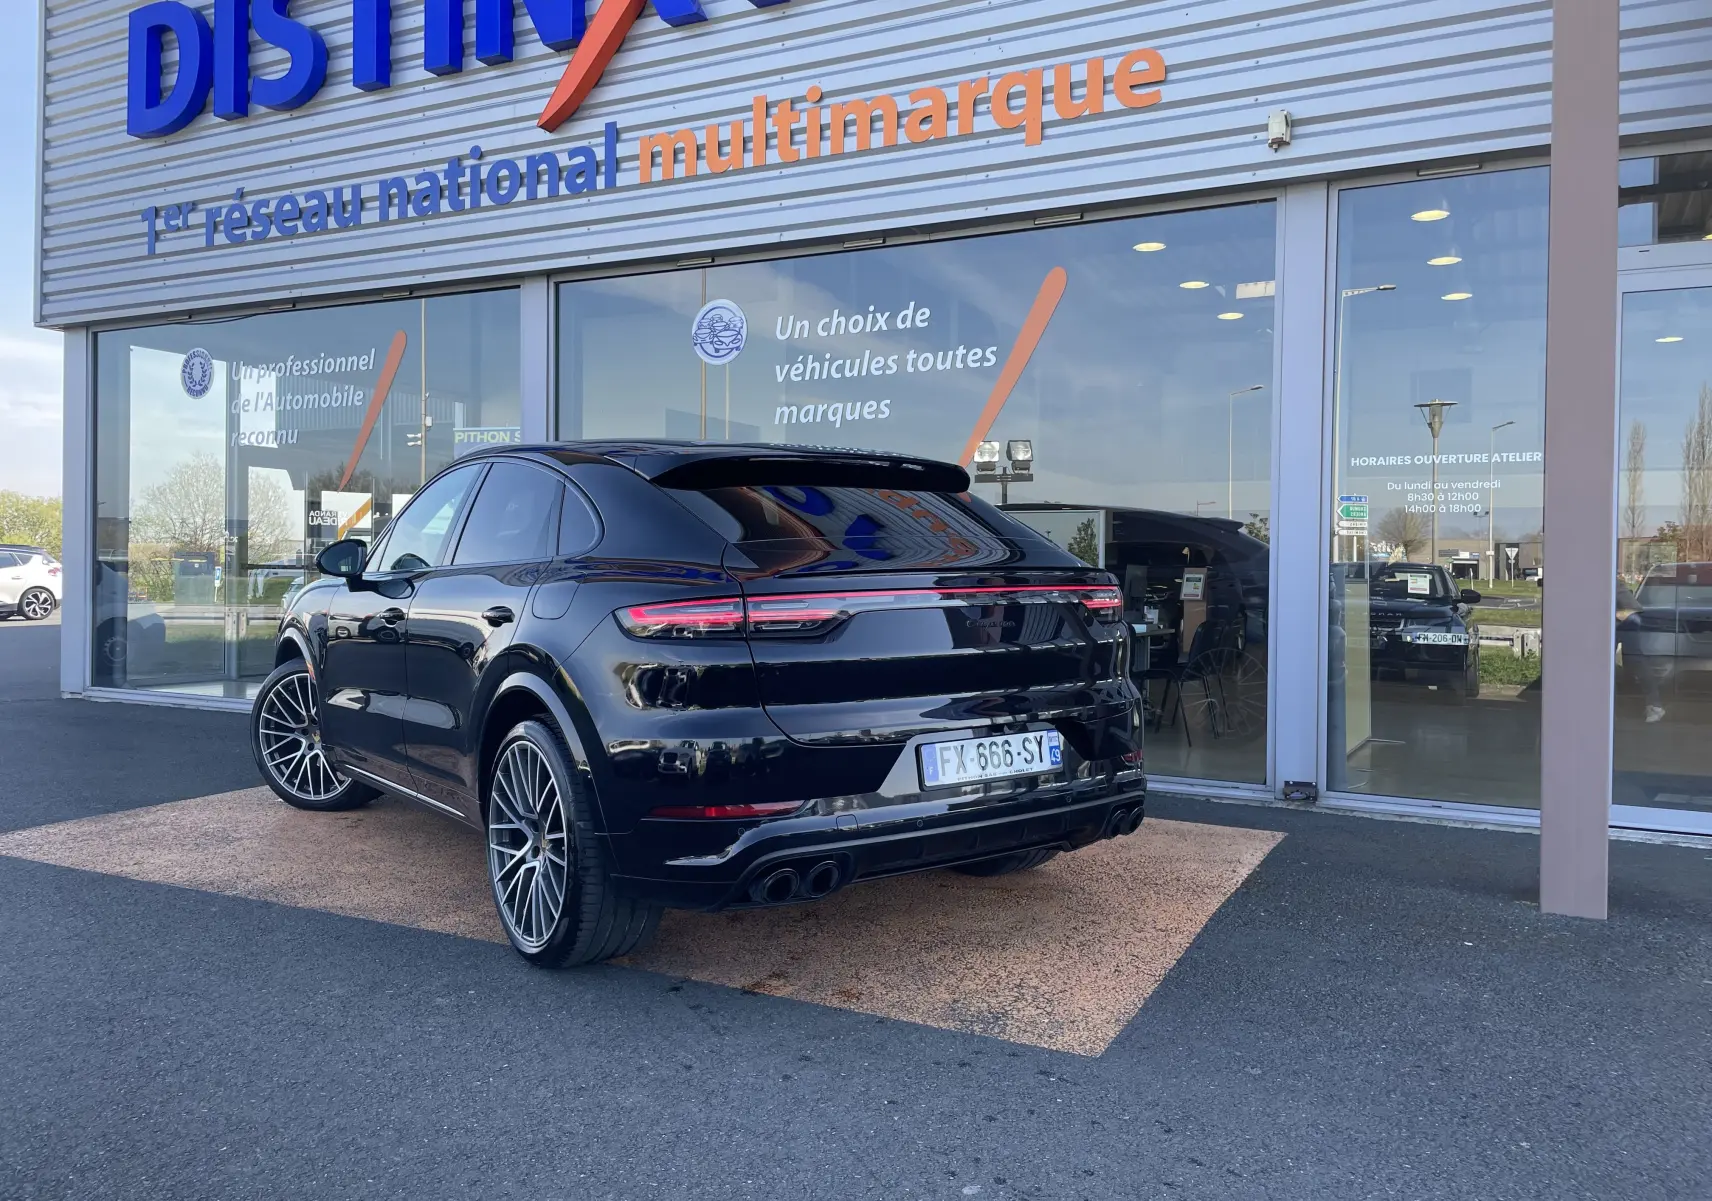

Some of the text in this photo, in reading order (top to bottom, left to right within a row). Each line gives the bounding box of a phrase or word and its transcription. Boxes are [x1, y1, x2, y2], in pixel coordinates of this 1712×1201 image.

[141, 48, 1167, 255] 1er réseau national multimarque
[776, 301, 931, 341] Un choix de
[231, 347, 376, 384] Un professionnel
[776, 345, 997, 382] véhicules toutes
[231, 385, 364, 413] de l'Automobile
[774, 399, 892, 428] marques
[231, 428, 299, 447] reconnu
[454, 431, 510, 443] PITHON
[1351, 452, 1543, 467] HORAIRES OUVERTURE ATELIER
[1387, 482, 1402, 490] Du
[1404, 481, 1432, 490] lundi
[1451, 480, 1501, 489] vendredi
[1407, 492, 1479, 502] 8h30 à 12h00
[1405, 503, 1481, 513] 14h00 à 18h00
[939, 734, 1044, 777] FX-666-SY
[1050, 748, 1061, 762] 49
